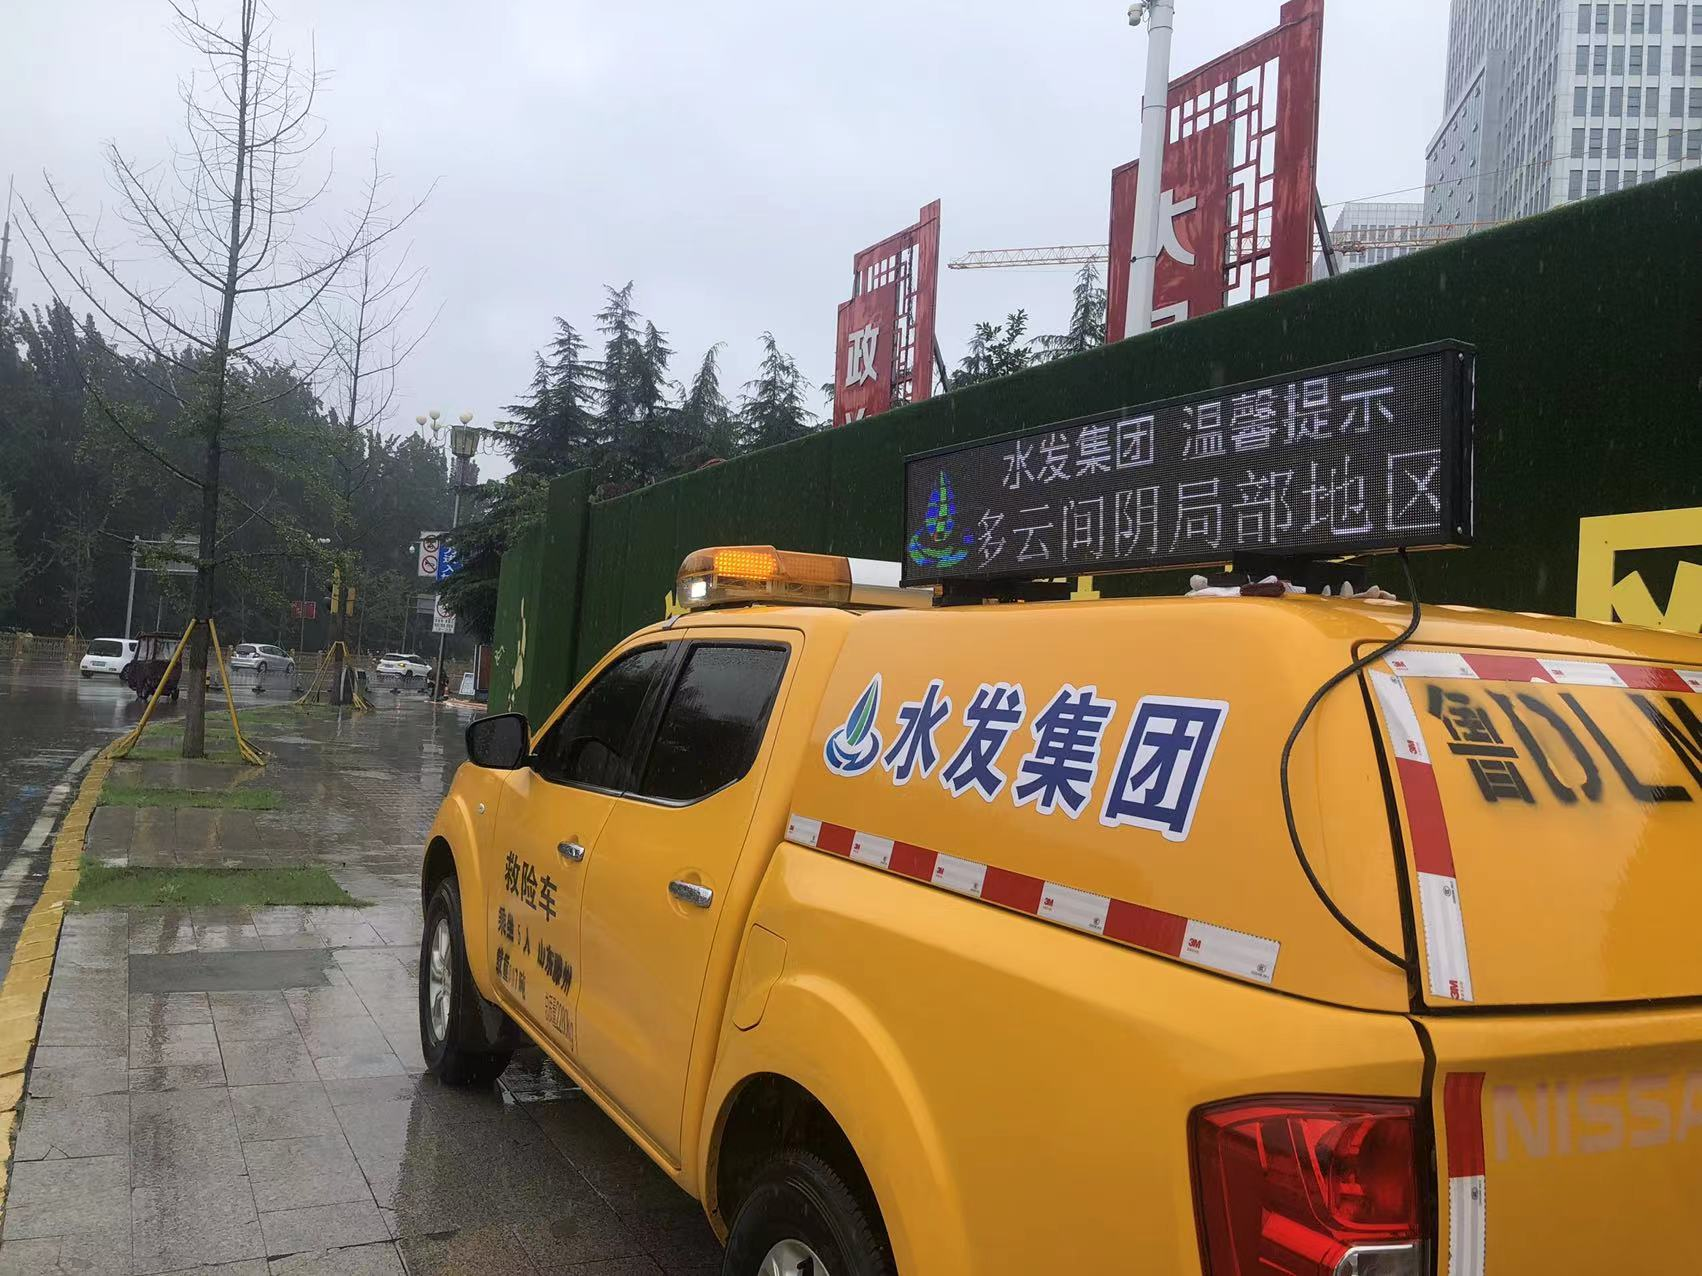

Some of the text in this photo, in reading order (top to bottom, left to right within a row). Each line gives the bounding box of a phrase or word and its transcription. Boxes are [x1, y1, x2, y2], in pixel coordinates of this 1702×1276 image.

[1002, 369, 1395, 490] 水发集团 温馨提示
[977, 449, 1441, 569] 多云间阴局部地区
[882, 681, 1226, 838] 水发集团
[504, 850, 558, 922] 救险车
[1189, 937, 1202, 949] 3M
[1449, 979, 1460, 1000] 3M
